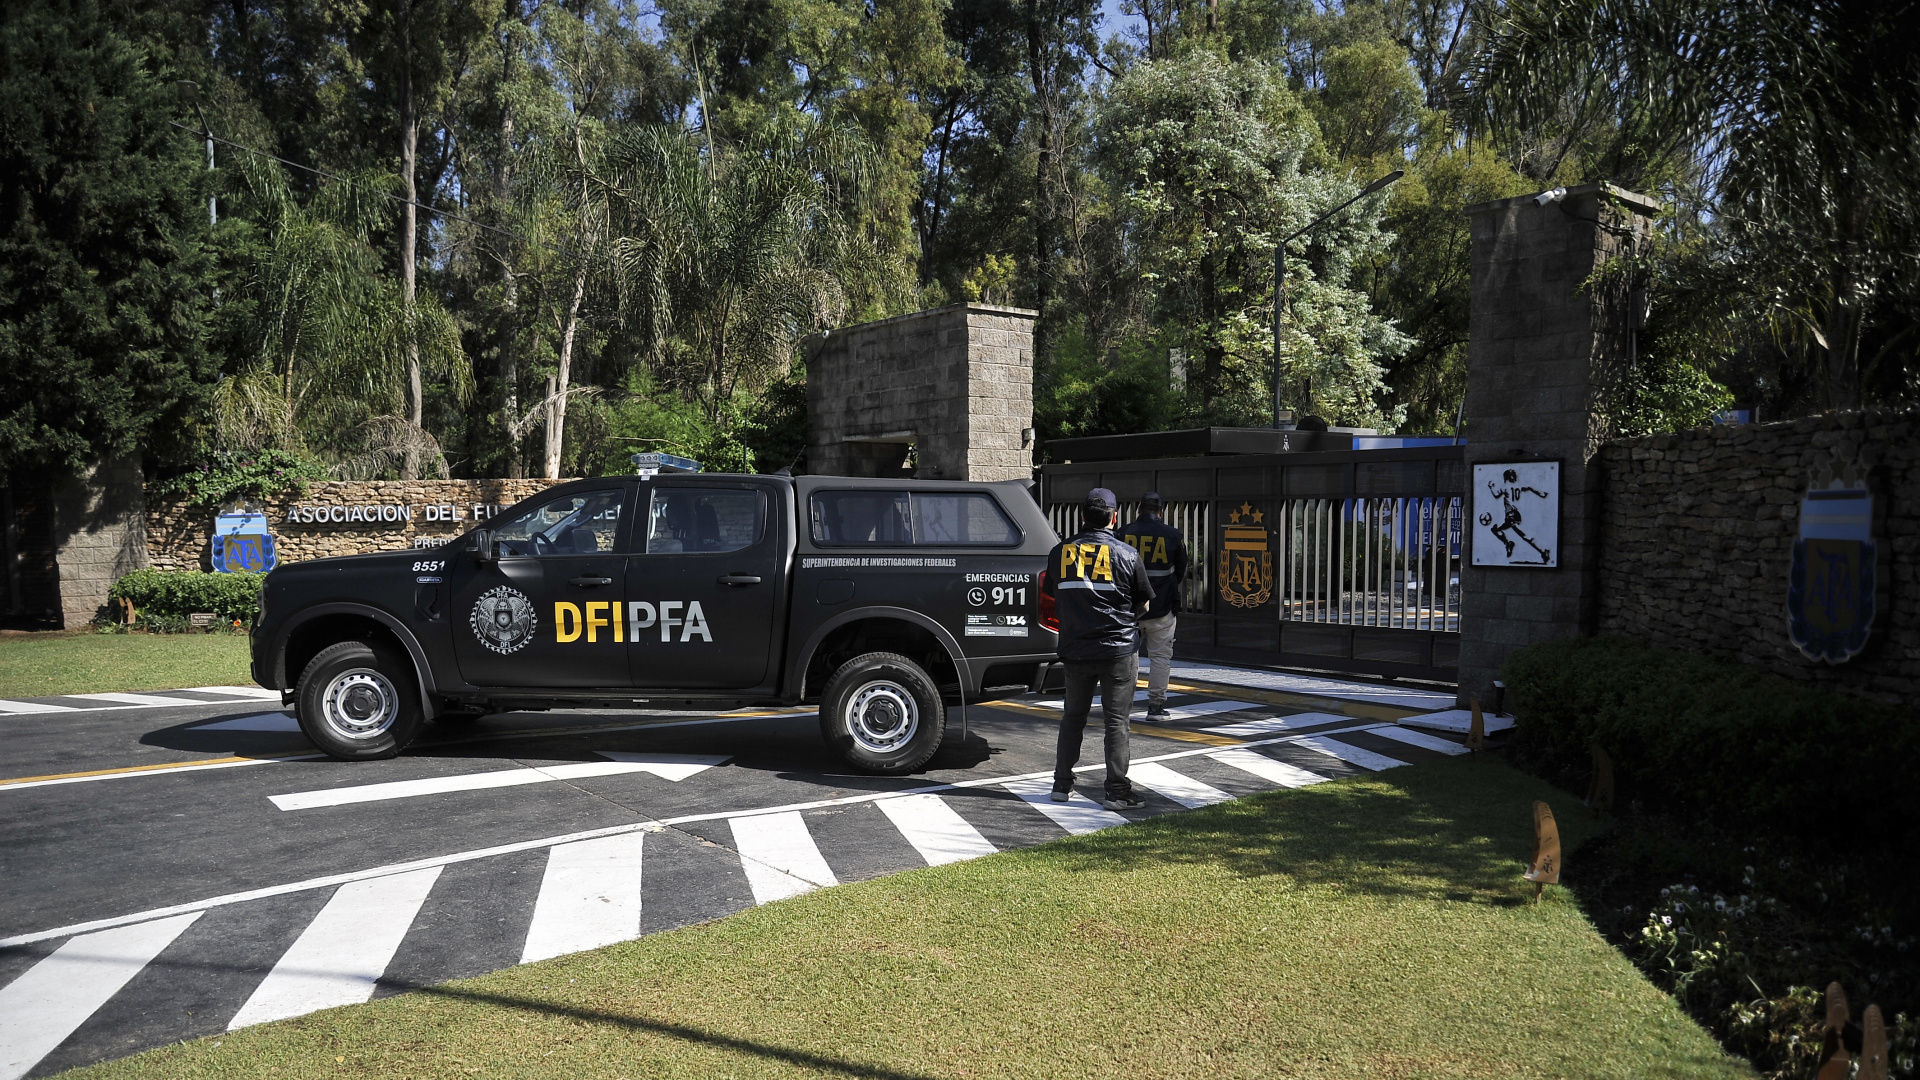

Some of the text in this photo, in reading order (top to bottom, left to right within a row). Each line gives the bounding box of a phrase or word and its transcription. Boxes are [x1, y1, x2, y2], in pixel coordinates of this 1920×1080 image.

[1511, 487, 1520, 501] 10
[287, 505, 411, 523] ASOCIACION
[426, 505, 463, 521] DEL
[412, 560, 445, 571] 8551
[802, 558, 957, 568] SUPERINTENDENCIA DE INVESTIGACIONES FEDERALES
[1060, 543, 1113, 581] PFA
[965, 573, 1030, 583] EMERGENCIAS
[991, 586, 1026, 606] 911
[1005, 615, 1027, 625] 134
